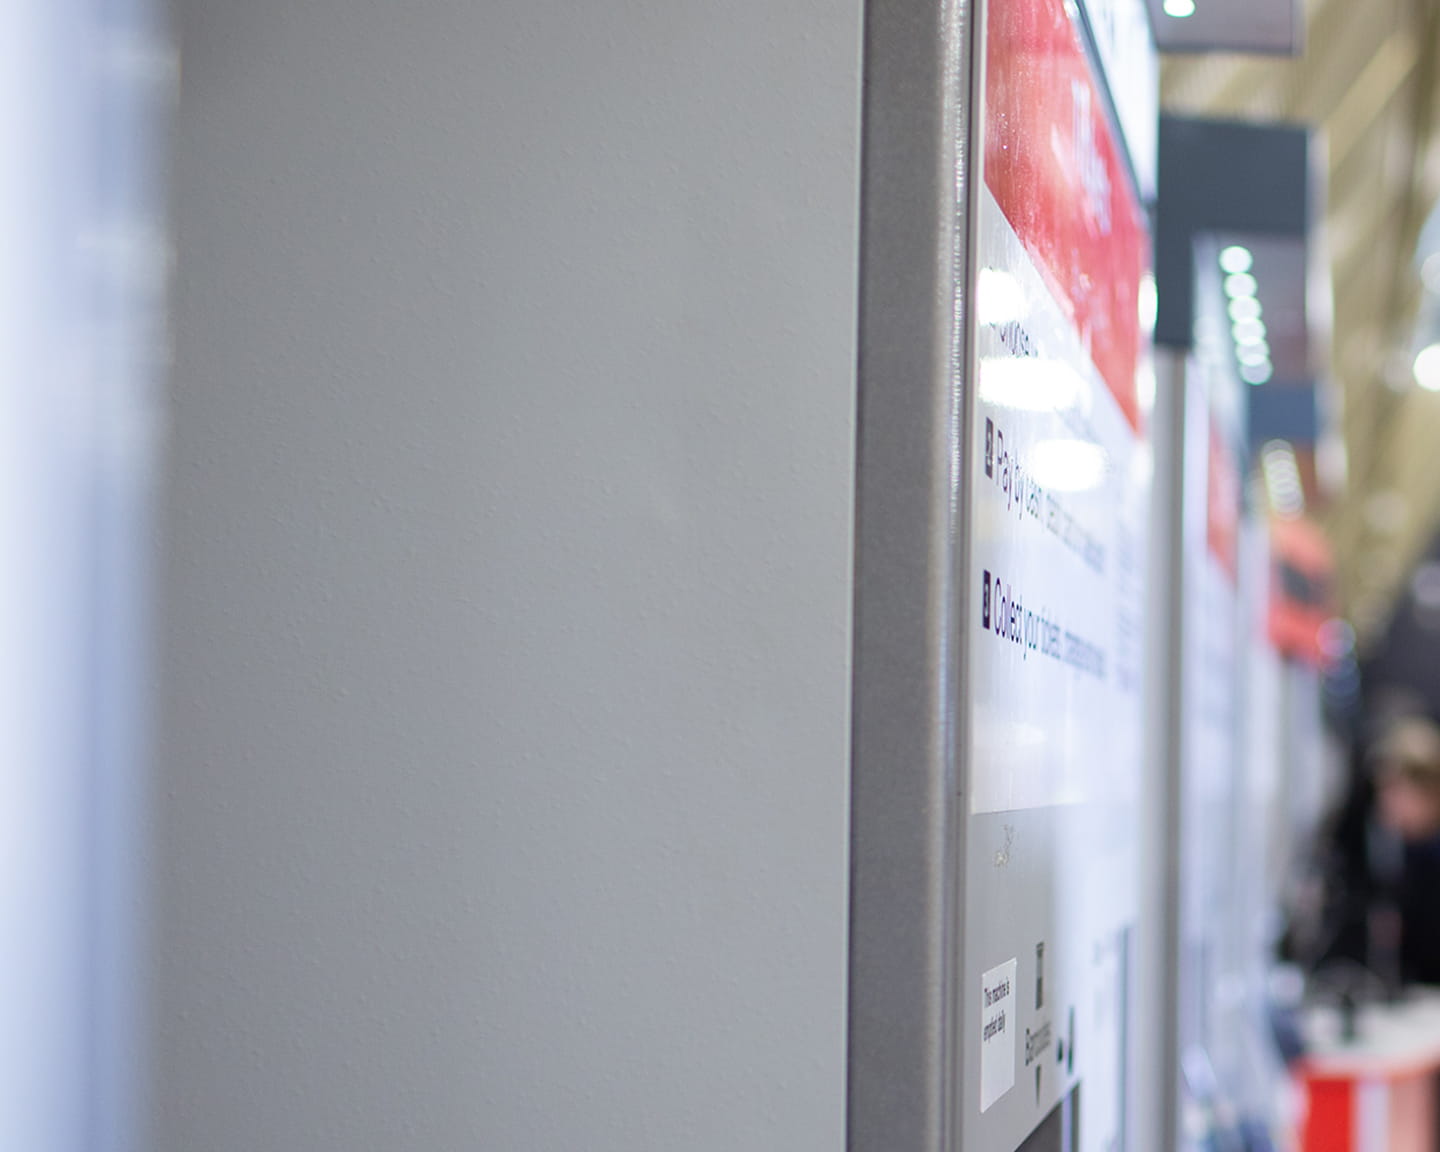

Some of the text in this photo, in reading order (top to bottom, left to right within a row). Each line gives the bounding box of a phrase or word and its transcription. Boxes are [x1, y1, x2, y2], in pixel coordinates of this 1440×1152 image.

[997, 429, 1013, 511] Pay
[994, 577, 1023, 645] Collect
[1023, 608, 1040, 660] your
